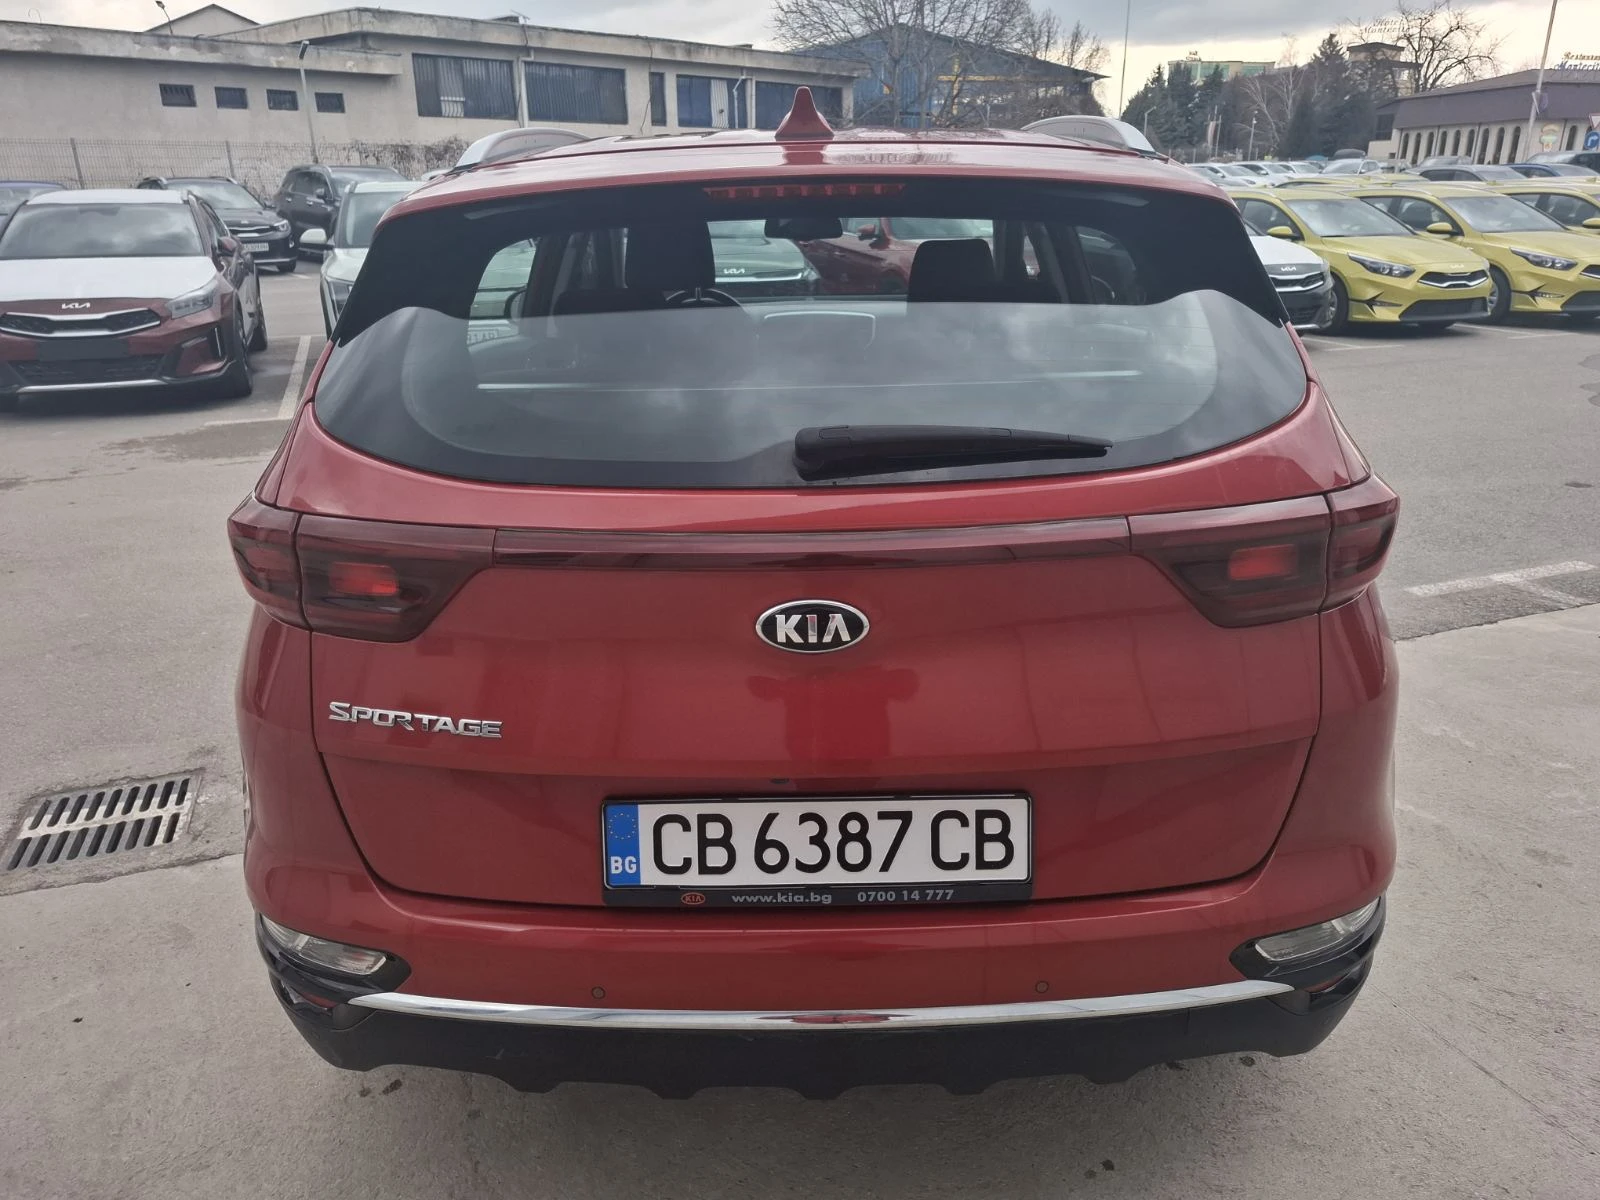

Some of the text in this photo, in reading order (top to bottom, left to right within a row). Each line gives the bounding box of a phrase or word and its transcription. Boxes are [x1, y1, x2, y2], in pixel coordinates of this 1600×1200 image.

[1373, 18, 1403, 27] Hotel
[775, 613, 851, 643] KIA
[328, 701, 503, 738] SPORTAGE
[653, 809, 1014, 875] CB 6387 CB
[610, 856, 637, 874] BG
[732, 889, 954, 904] www.kia.bg 0700 14 777
